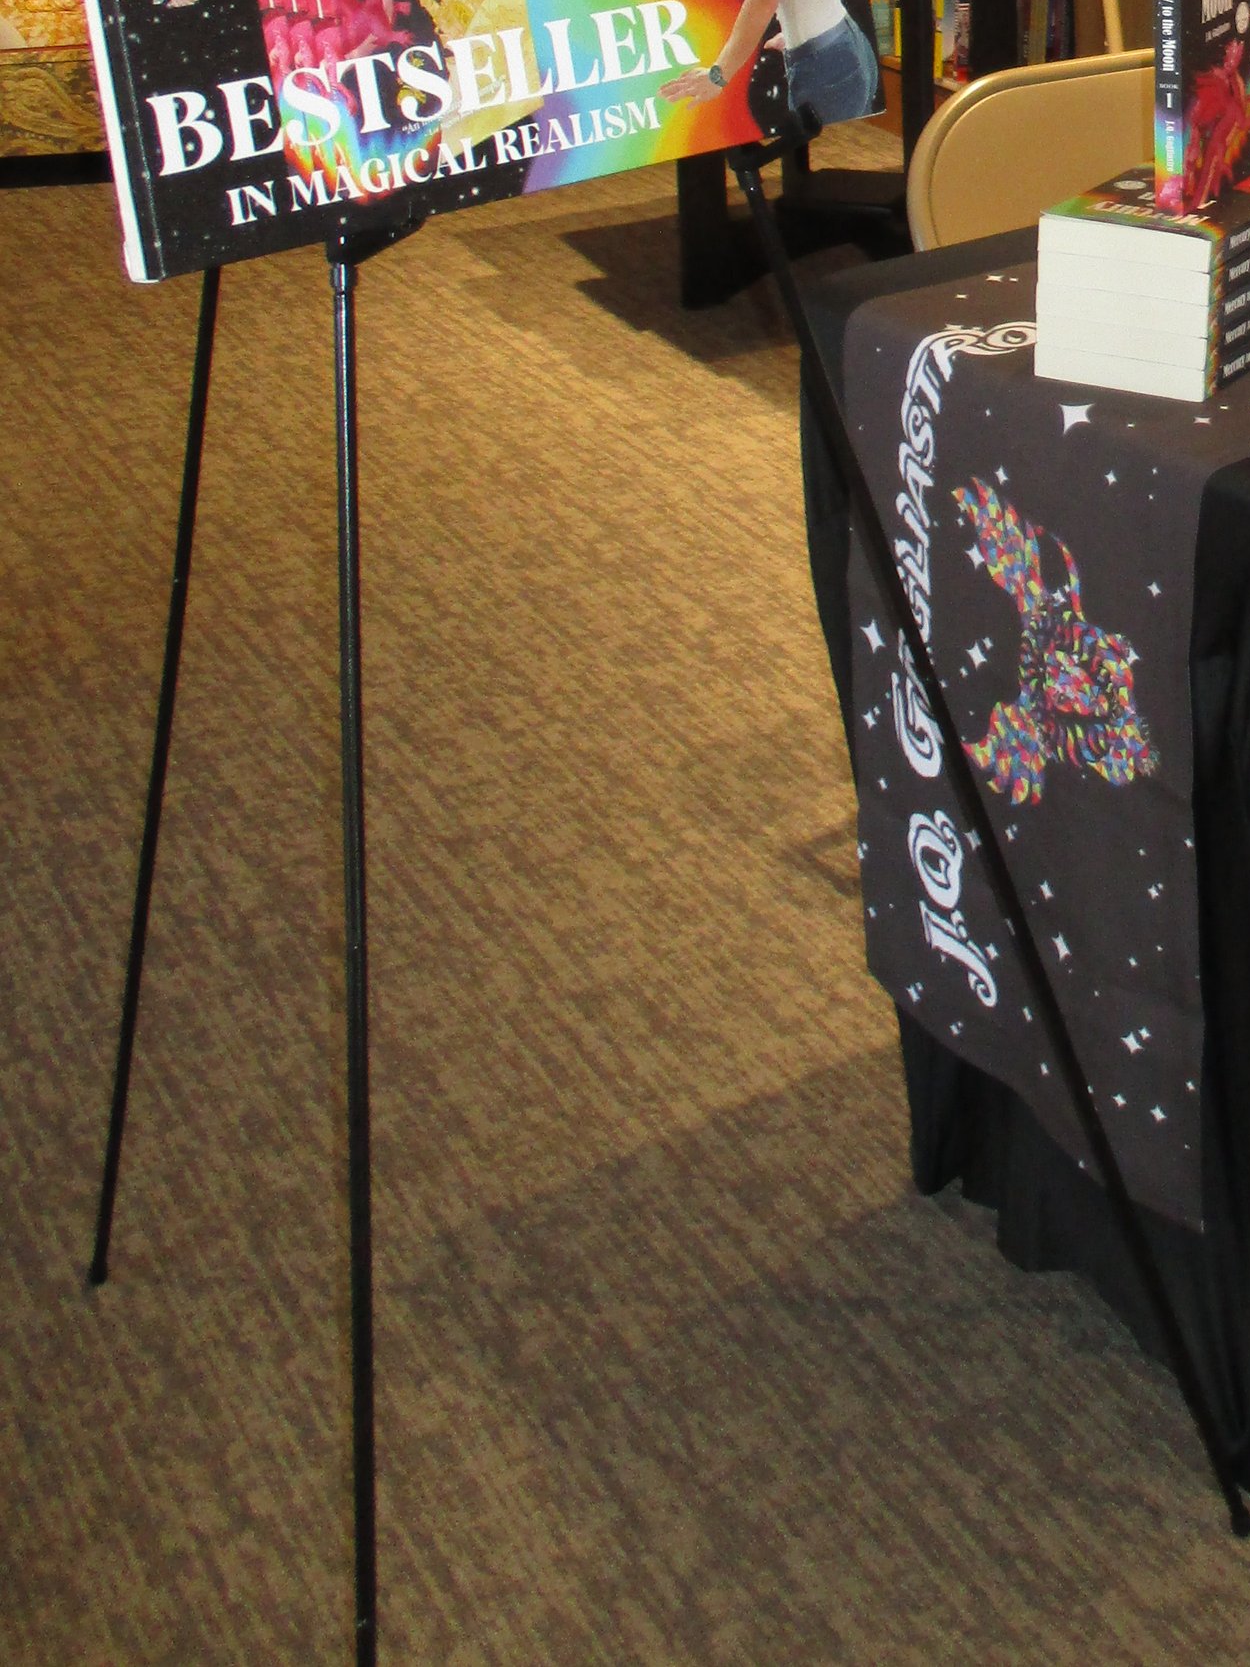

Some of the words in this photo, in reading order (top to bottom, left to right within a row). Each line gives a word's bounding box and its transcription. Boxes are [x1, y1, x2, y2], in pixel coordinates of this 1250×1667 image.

[1162, 5, 1175, 16] to
[1162, 18, 1175, 36] the
[1161, 39, 1176, 72] Moon
[225, 180, 279, 227] IN
[286, 139, 488, 213] MAGICAL
[496, 97, 662, 166] REALISM
